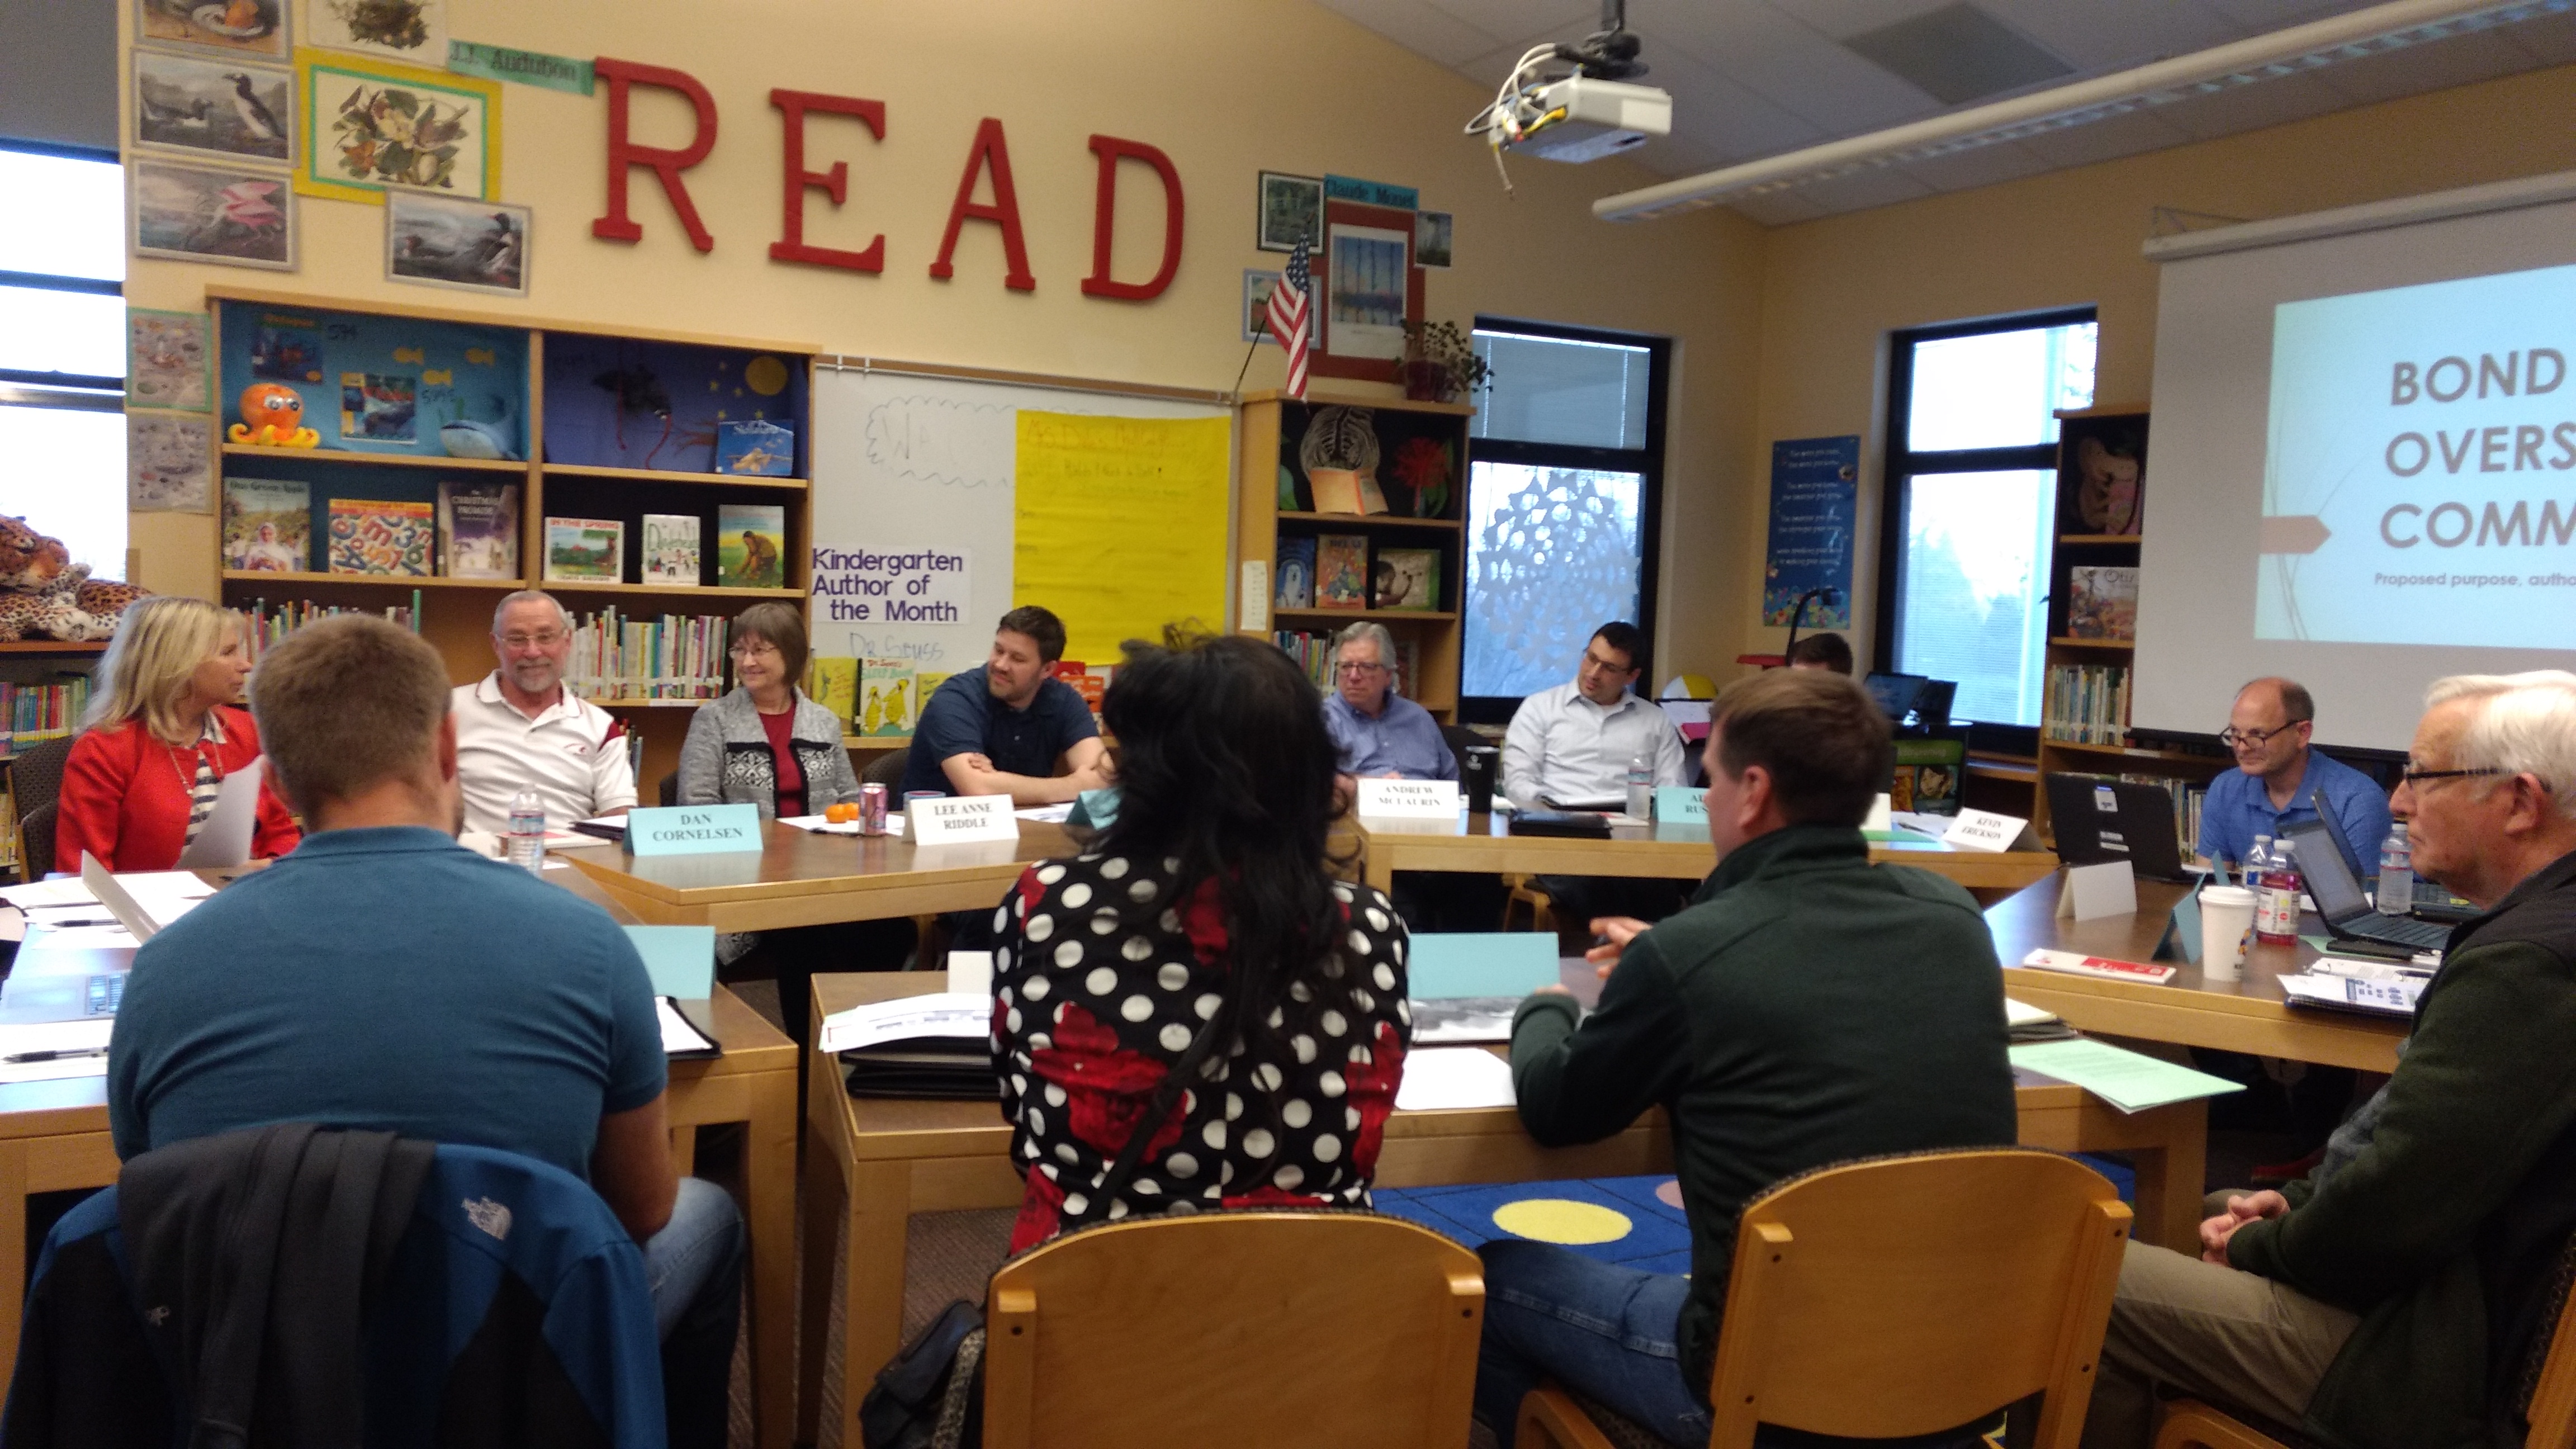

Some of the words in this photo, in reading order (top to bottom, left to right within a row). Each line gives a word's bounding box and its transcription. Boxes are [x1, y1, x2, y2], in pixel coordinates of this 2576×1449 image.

[592, 56, 1185, 301] READ
[2390, 348, 2567, 406] BOND
[2385, 422, 2576, 477] OVERS
[2380, 499, 2576, 549] COMM
[812, 547, 963, 576] Kindergarten
[812, 574, 893, 596] Author
[906, 574, 931, 595] of
[2374, 573, 2446, 587] Proposed
[2451, 575, 2523, 588] purpose,
[830, 599, 870, 620] the
[885, 600, 958, 622] Month
[1385, 785, 1433, 794] ANDREW
[680, 813, 712, 826] DAN
[934, 804, 958, 816] LEE
[961, 802, 993, 814] ANNE
[652, 827, 743, 842] CORNELSEN
[943, 817, 988, 830] RIDDLE
